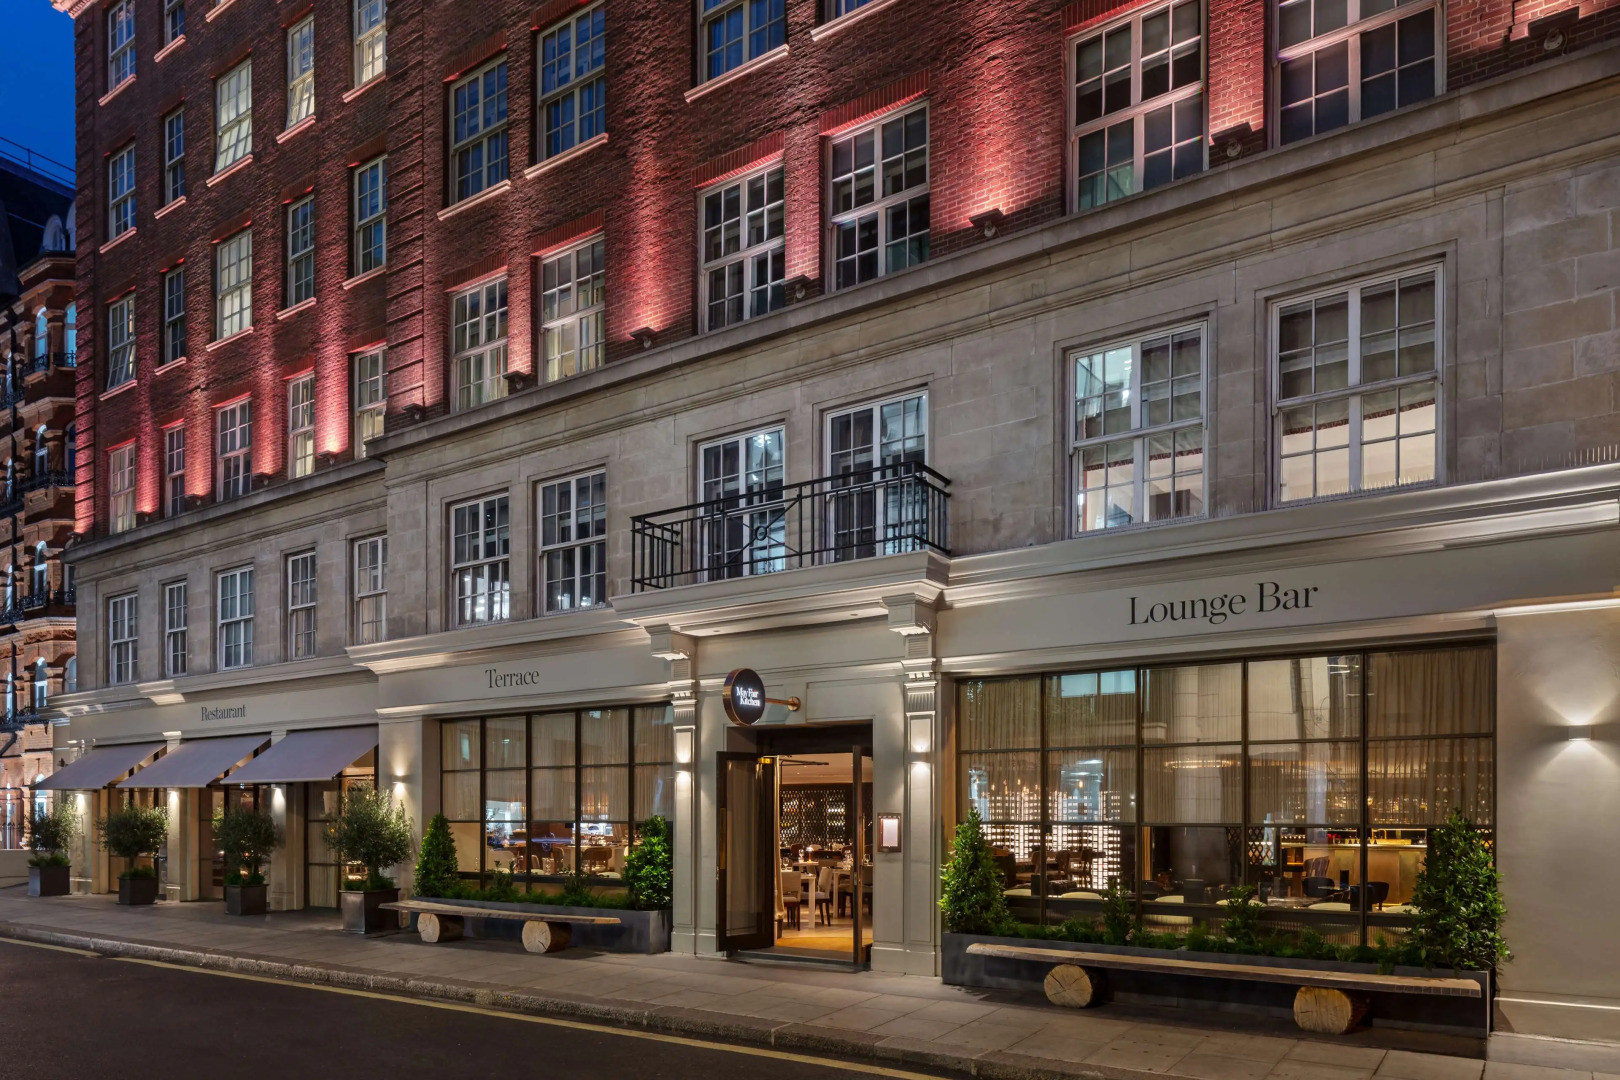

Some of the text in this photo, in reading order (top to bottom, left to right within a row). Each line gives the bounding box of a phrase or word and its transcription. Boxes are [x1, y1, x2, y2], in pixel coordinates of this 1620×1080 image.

[1128, 581, 1319, 625] Lounge Bar
[485, 668, 540, 688] Terrace
[740, 696, 761, 707] Kitchen
[201, 703, 246, 721] Restaurant
